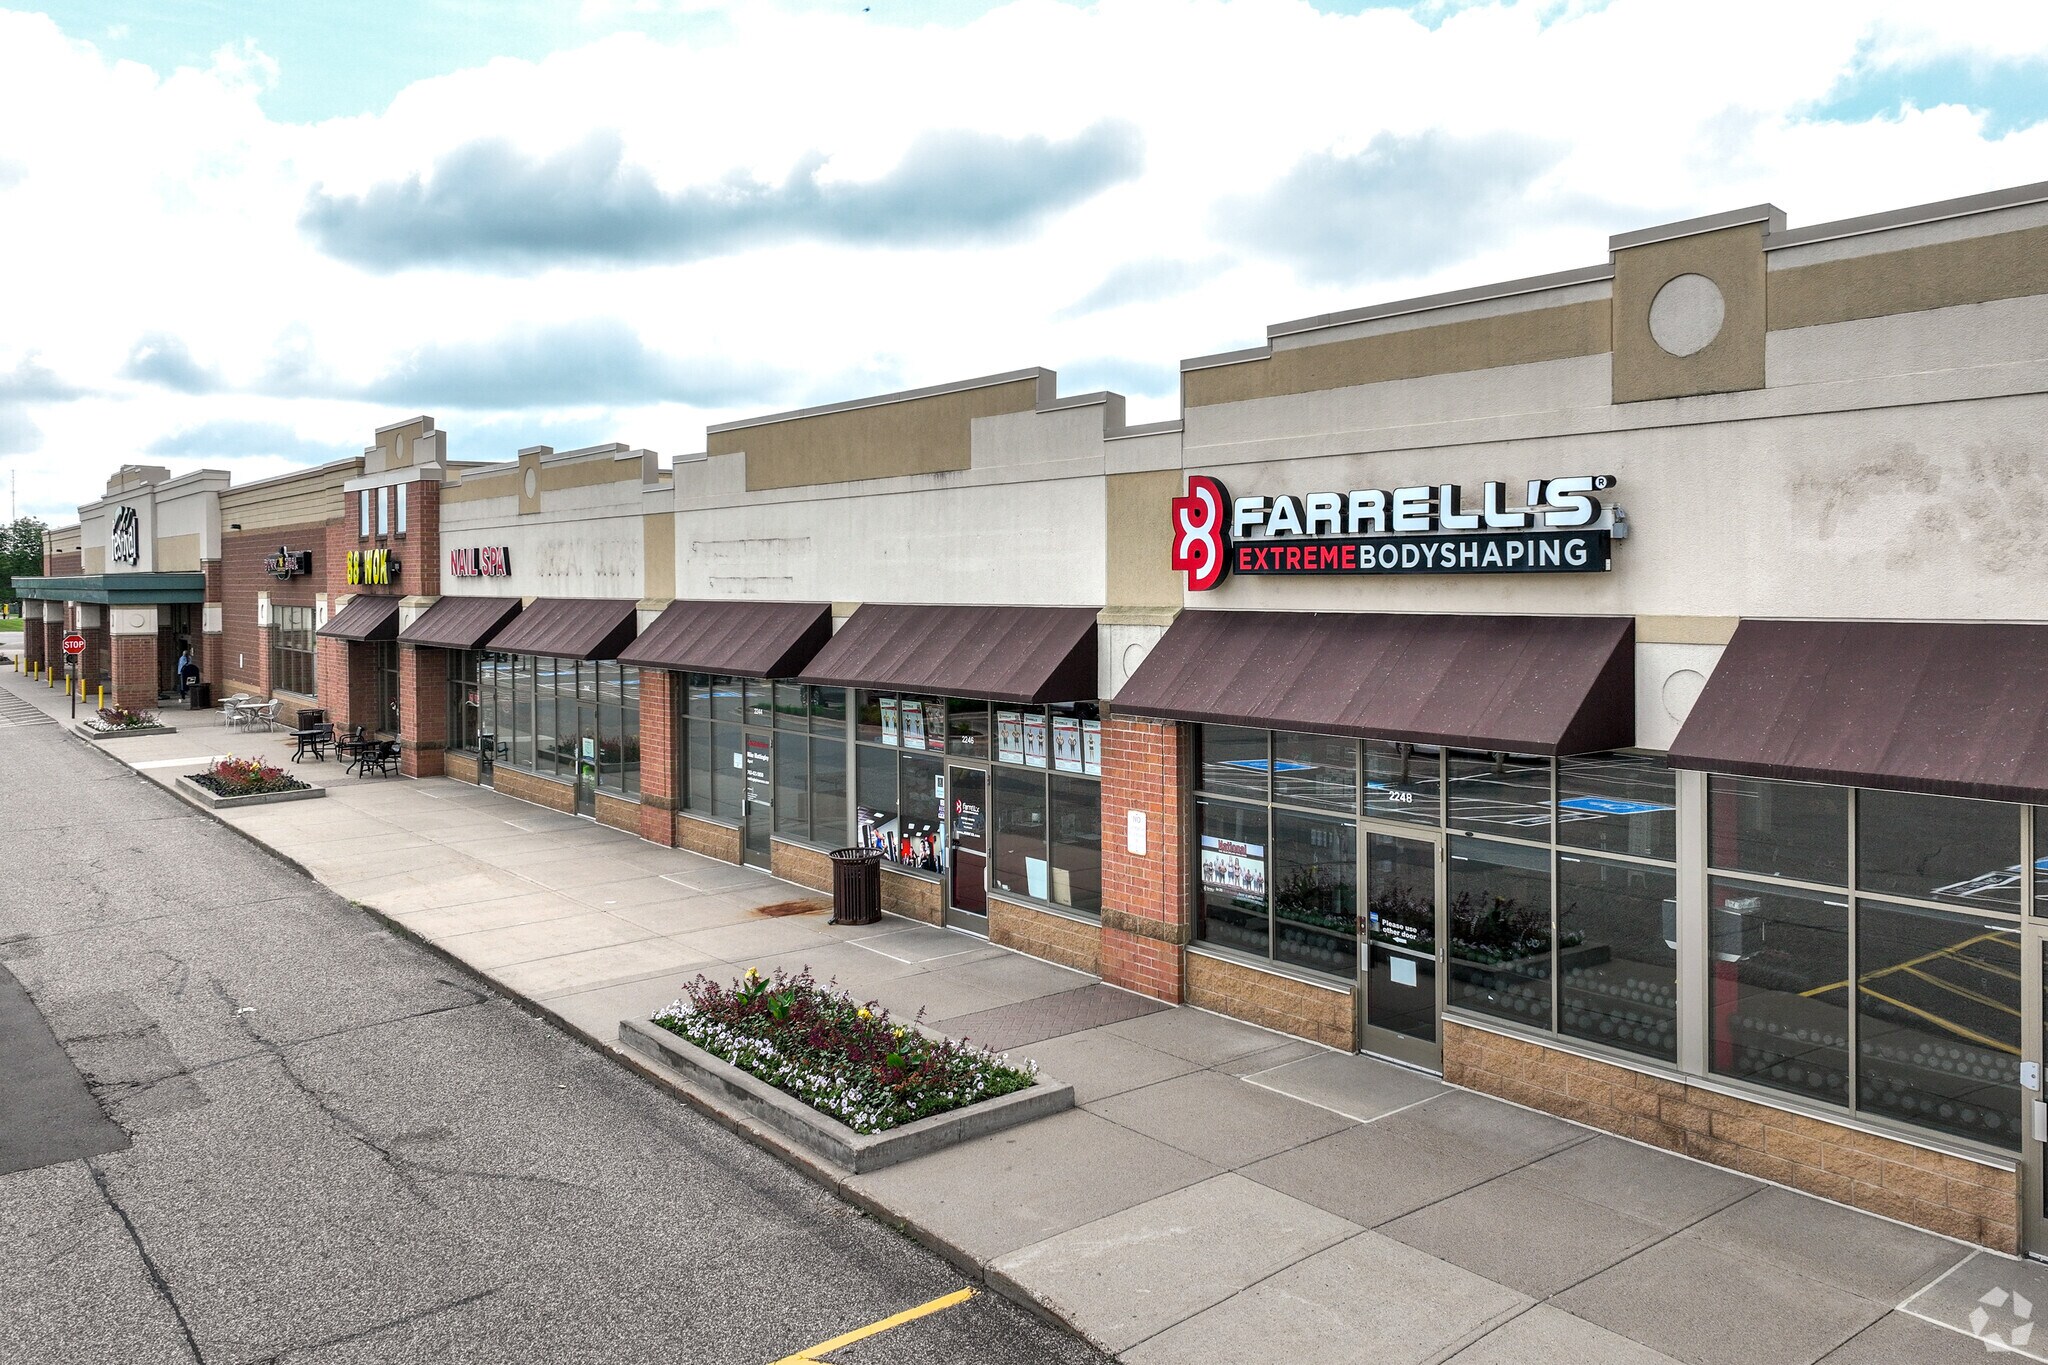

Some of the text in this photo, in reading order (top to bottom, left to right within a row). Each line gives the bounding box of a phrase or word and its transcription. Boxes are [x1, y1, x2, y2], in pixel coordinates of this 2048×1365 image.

[347, 548, 388, 586] 88 WOK
[450, 546, 506, 577] NAIL SPA
[64, 640, 84, 649] STOP
[961, 735, 975, 745] 2246
[1389, 790, 1413, 803] 2248
[1218, 839, 1247, 856] National
[1381, 918, 1418, 933] Please use
[1382, 927, 1417, 940] other door
